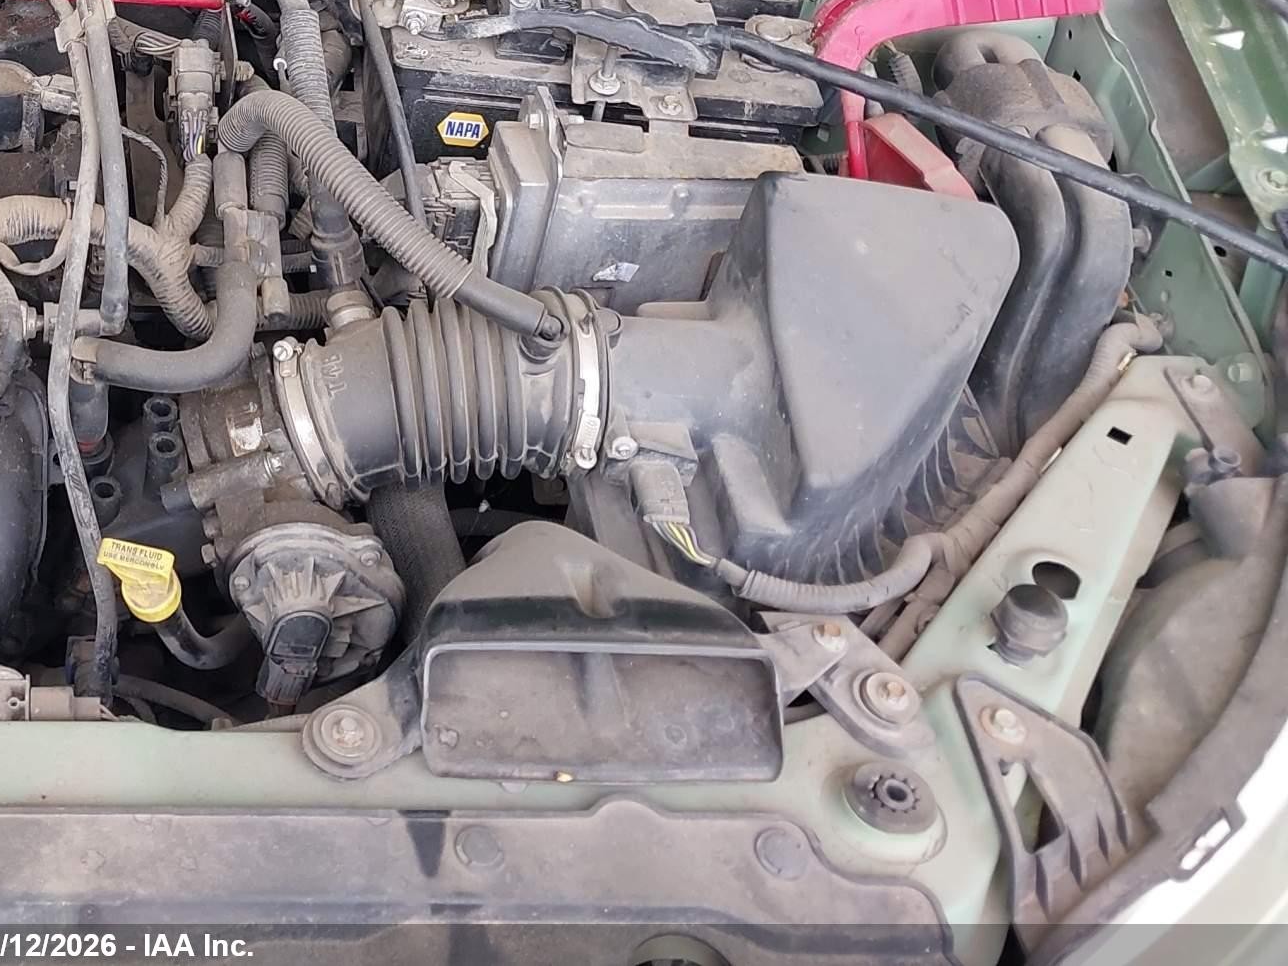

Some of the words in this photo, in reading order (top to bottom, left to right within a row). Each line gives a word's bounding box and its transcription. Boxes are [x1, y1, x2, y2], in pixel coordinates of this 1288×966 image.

[445, 121, 481, 139] NAPA
[111, 541, 138, 554] TRANS
[139, 548, 163, 561] FLUID
